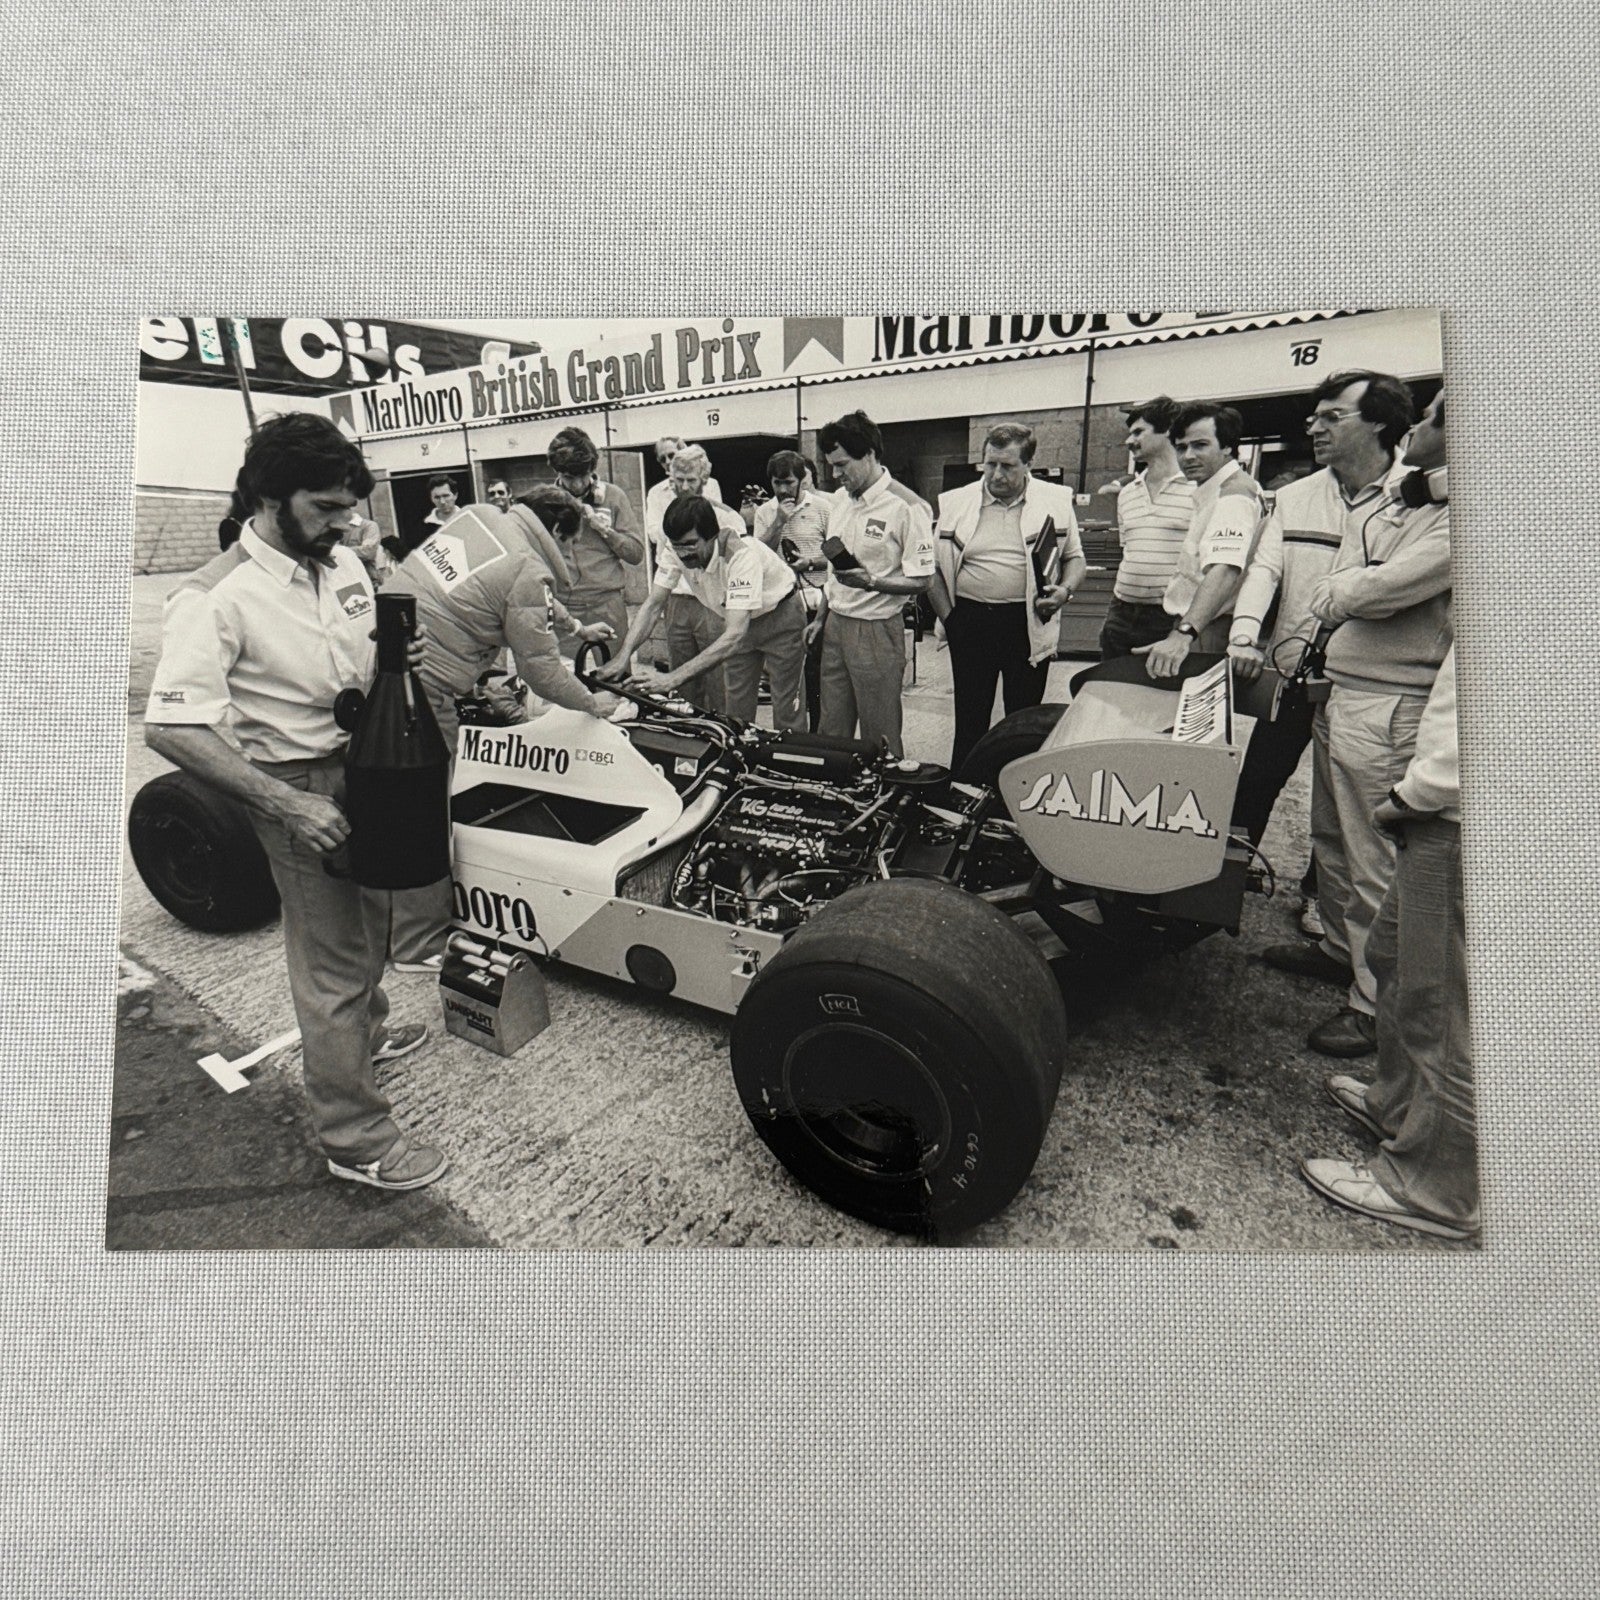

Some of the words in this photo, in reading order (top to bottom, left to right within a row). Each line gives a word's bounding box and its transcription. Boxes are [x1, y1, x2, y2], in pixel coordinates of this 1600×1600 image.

[871, 314, 1164, 362] Maro
[1290, 345, 1320, 367] 18
[361, 382, 463, 434] Marlboro
[468, 355, 560, 418] British
[567, 333, 666, 404] Grand
[676, 318, 762, 389] Prix
[707, 413, 720, 426] 19
[461, 729, 570, 775] Marlboro
